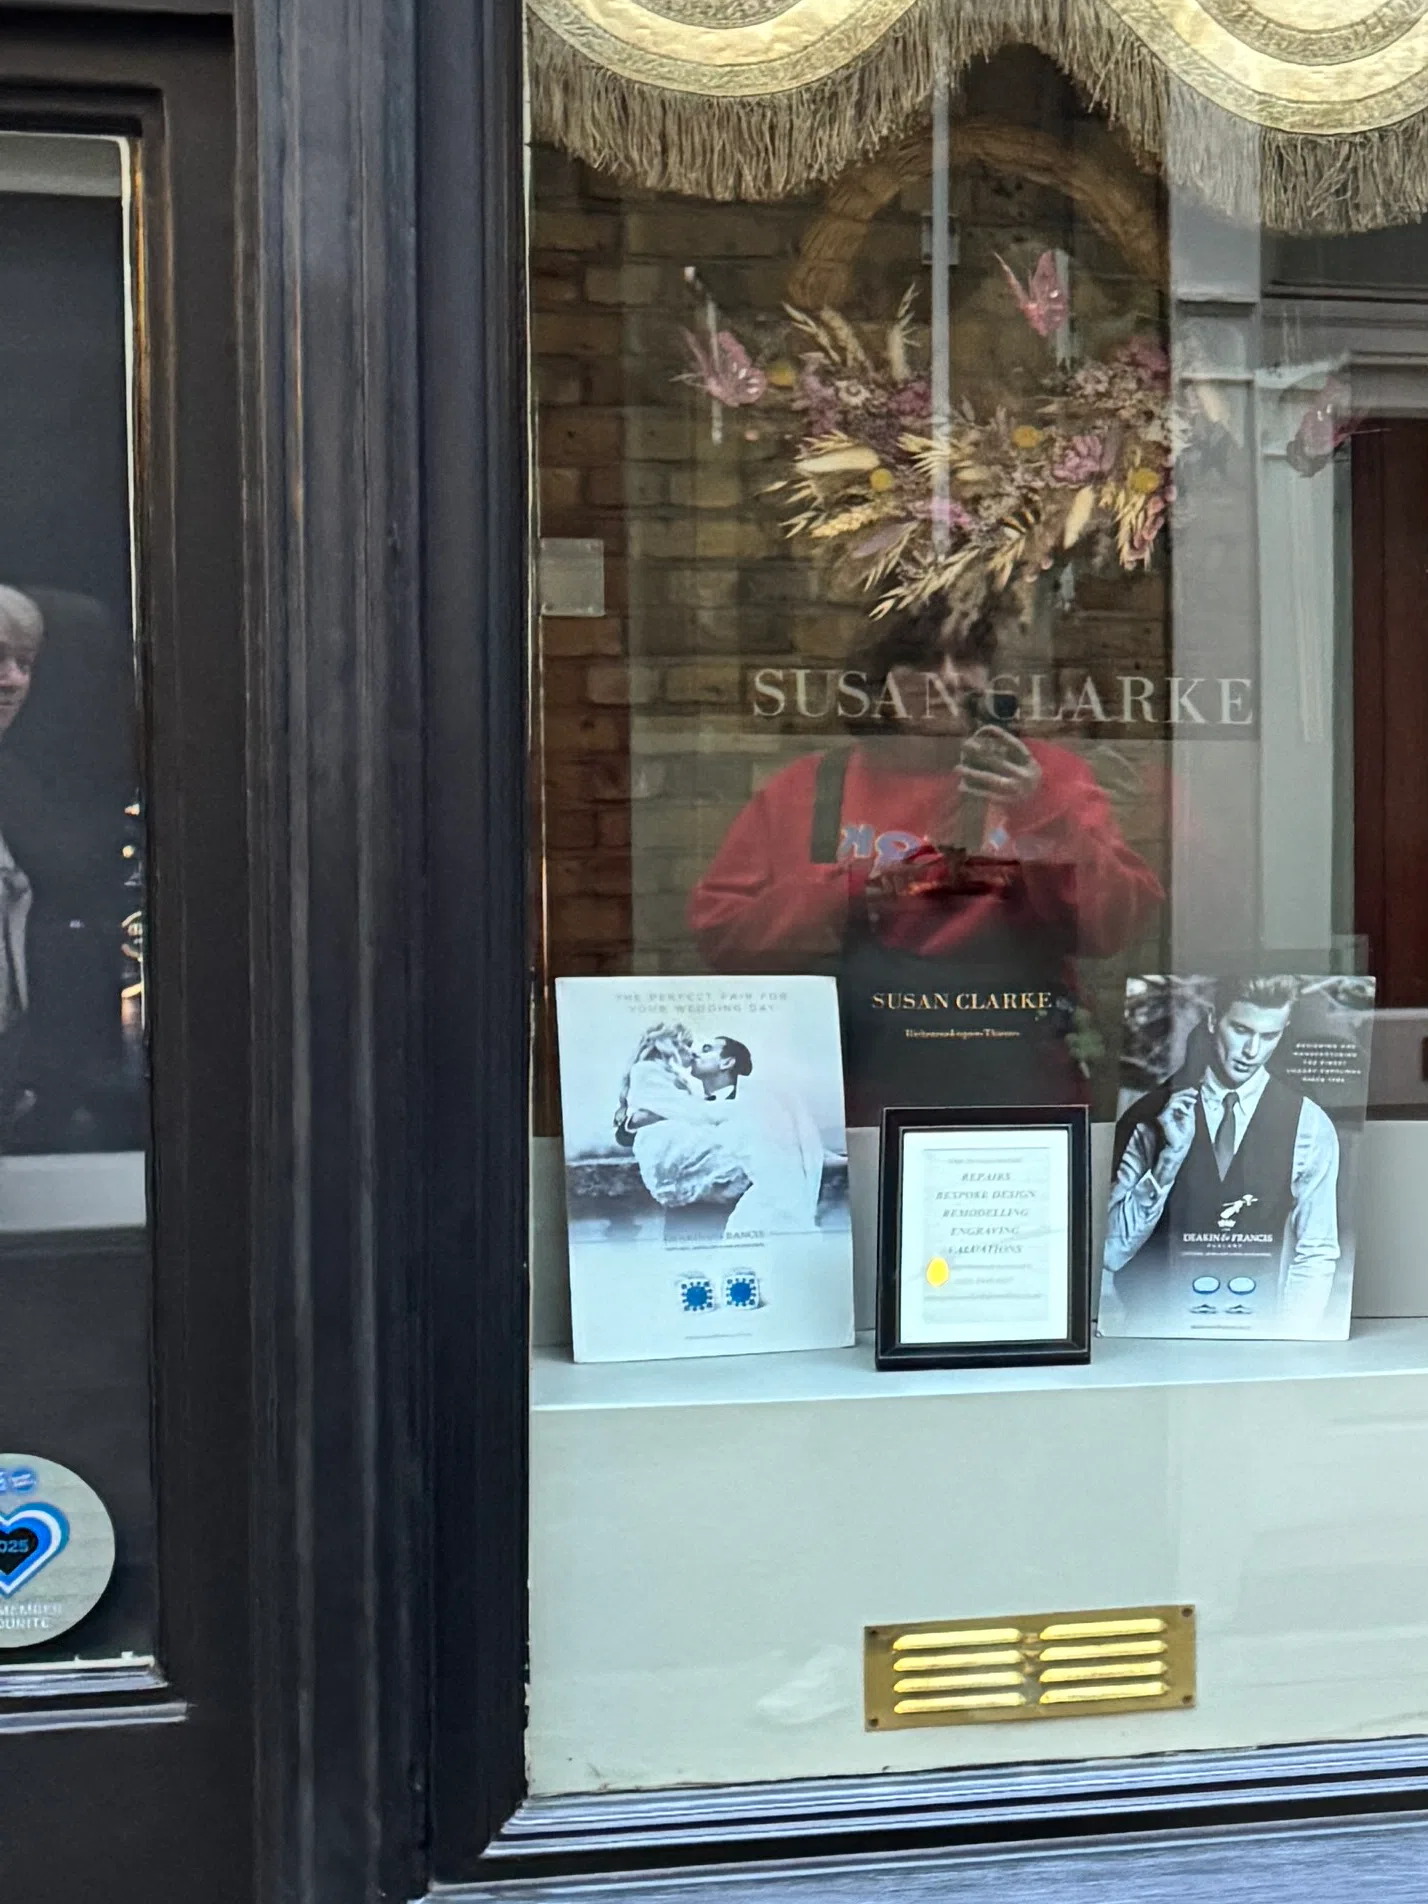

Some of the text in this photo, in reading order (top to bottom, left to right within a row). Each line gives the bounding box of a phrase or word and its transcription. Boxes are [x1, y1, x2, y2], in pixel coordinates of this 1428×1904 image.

[753, 668, 1254, 725] SUSAN CLARKE
[872, 992, 1053, 1010] SUSAN CLARKE
[961, 1172, 1012, 1182] REPAIRS
[936, 1190, 1037, 1200] BESPOKE DESIGN
[943, 1208, 1029, 1218] REMODELLING
[950, 1227, 1020, 1236] ENGRAVING
